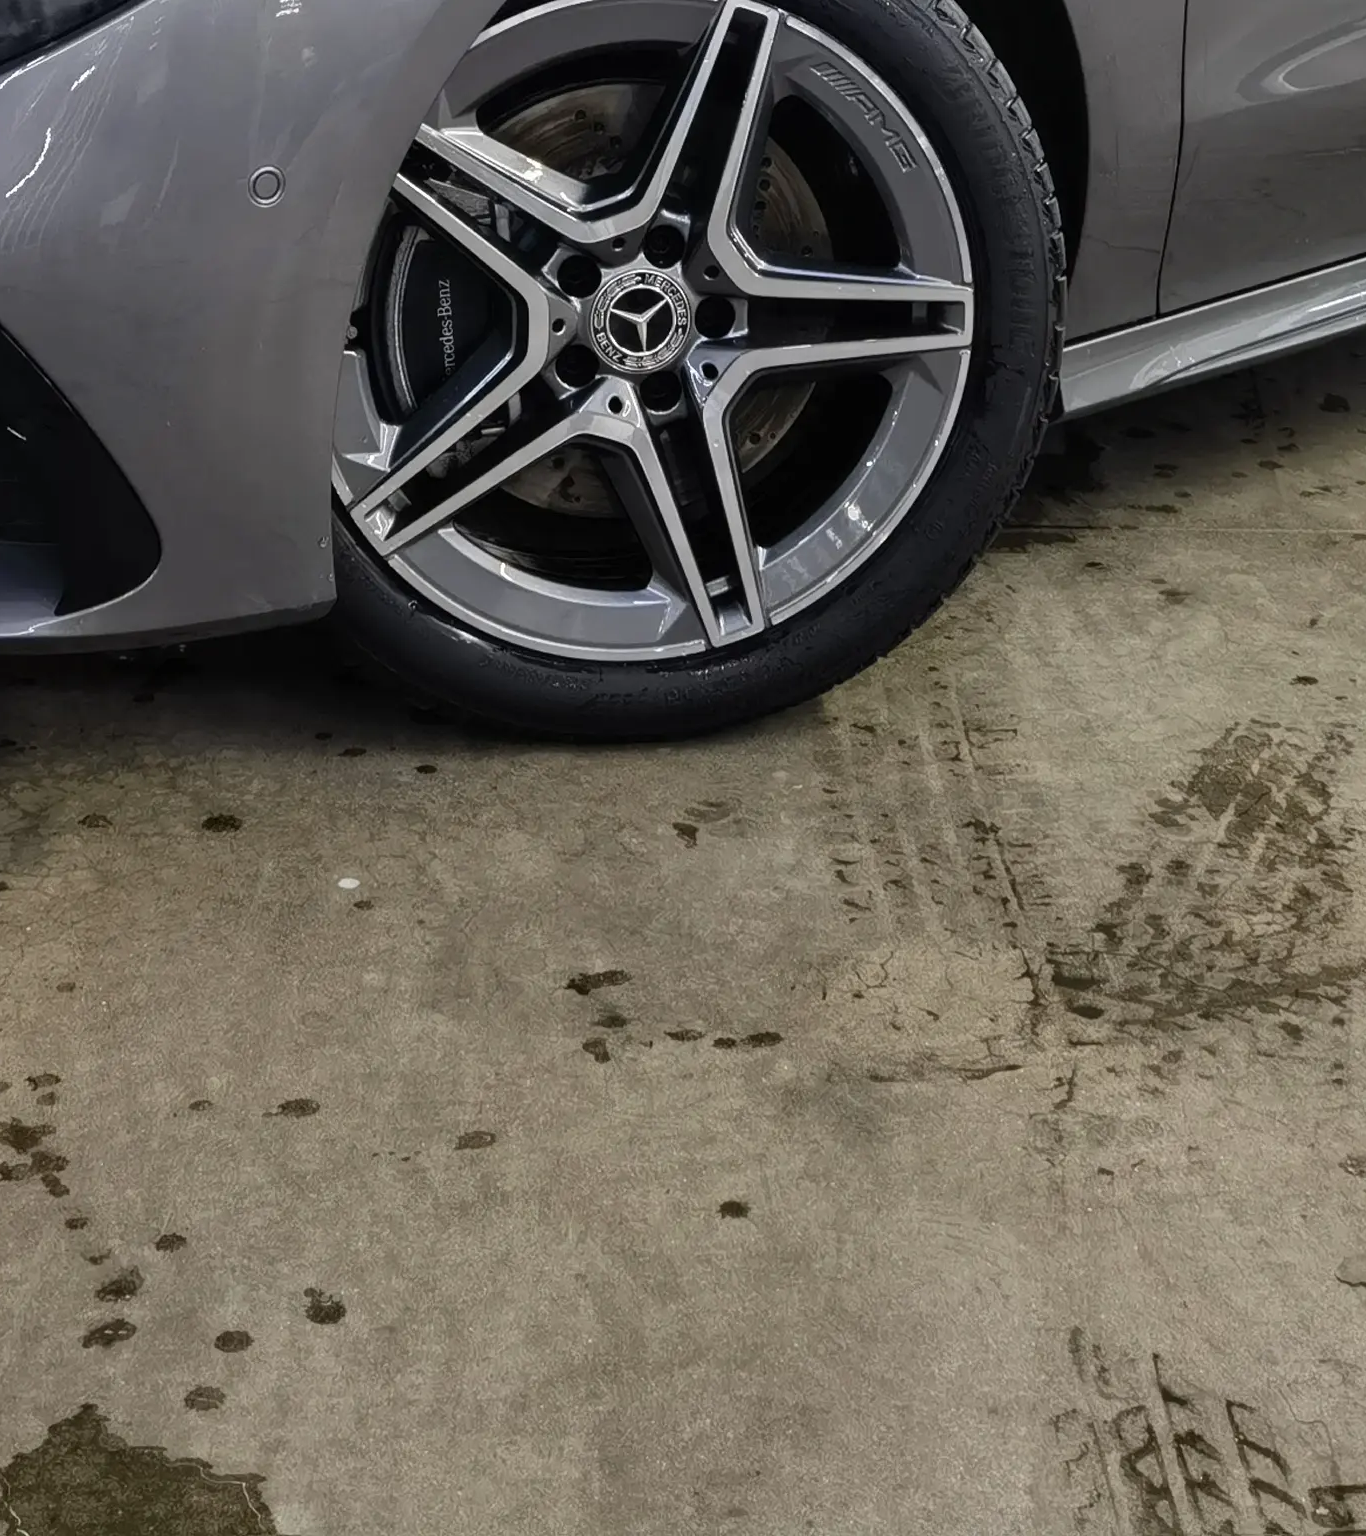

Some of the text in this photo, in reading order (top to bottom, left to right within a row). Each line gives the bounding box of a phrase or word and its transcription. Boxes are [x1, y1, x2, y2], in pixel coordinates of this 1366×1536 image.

[644, 273, 687, 326] MERCEDES
[437, 279, 455, 376] ercedes-Benz
[596, 332, 624, 363] BENZ
